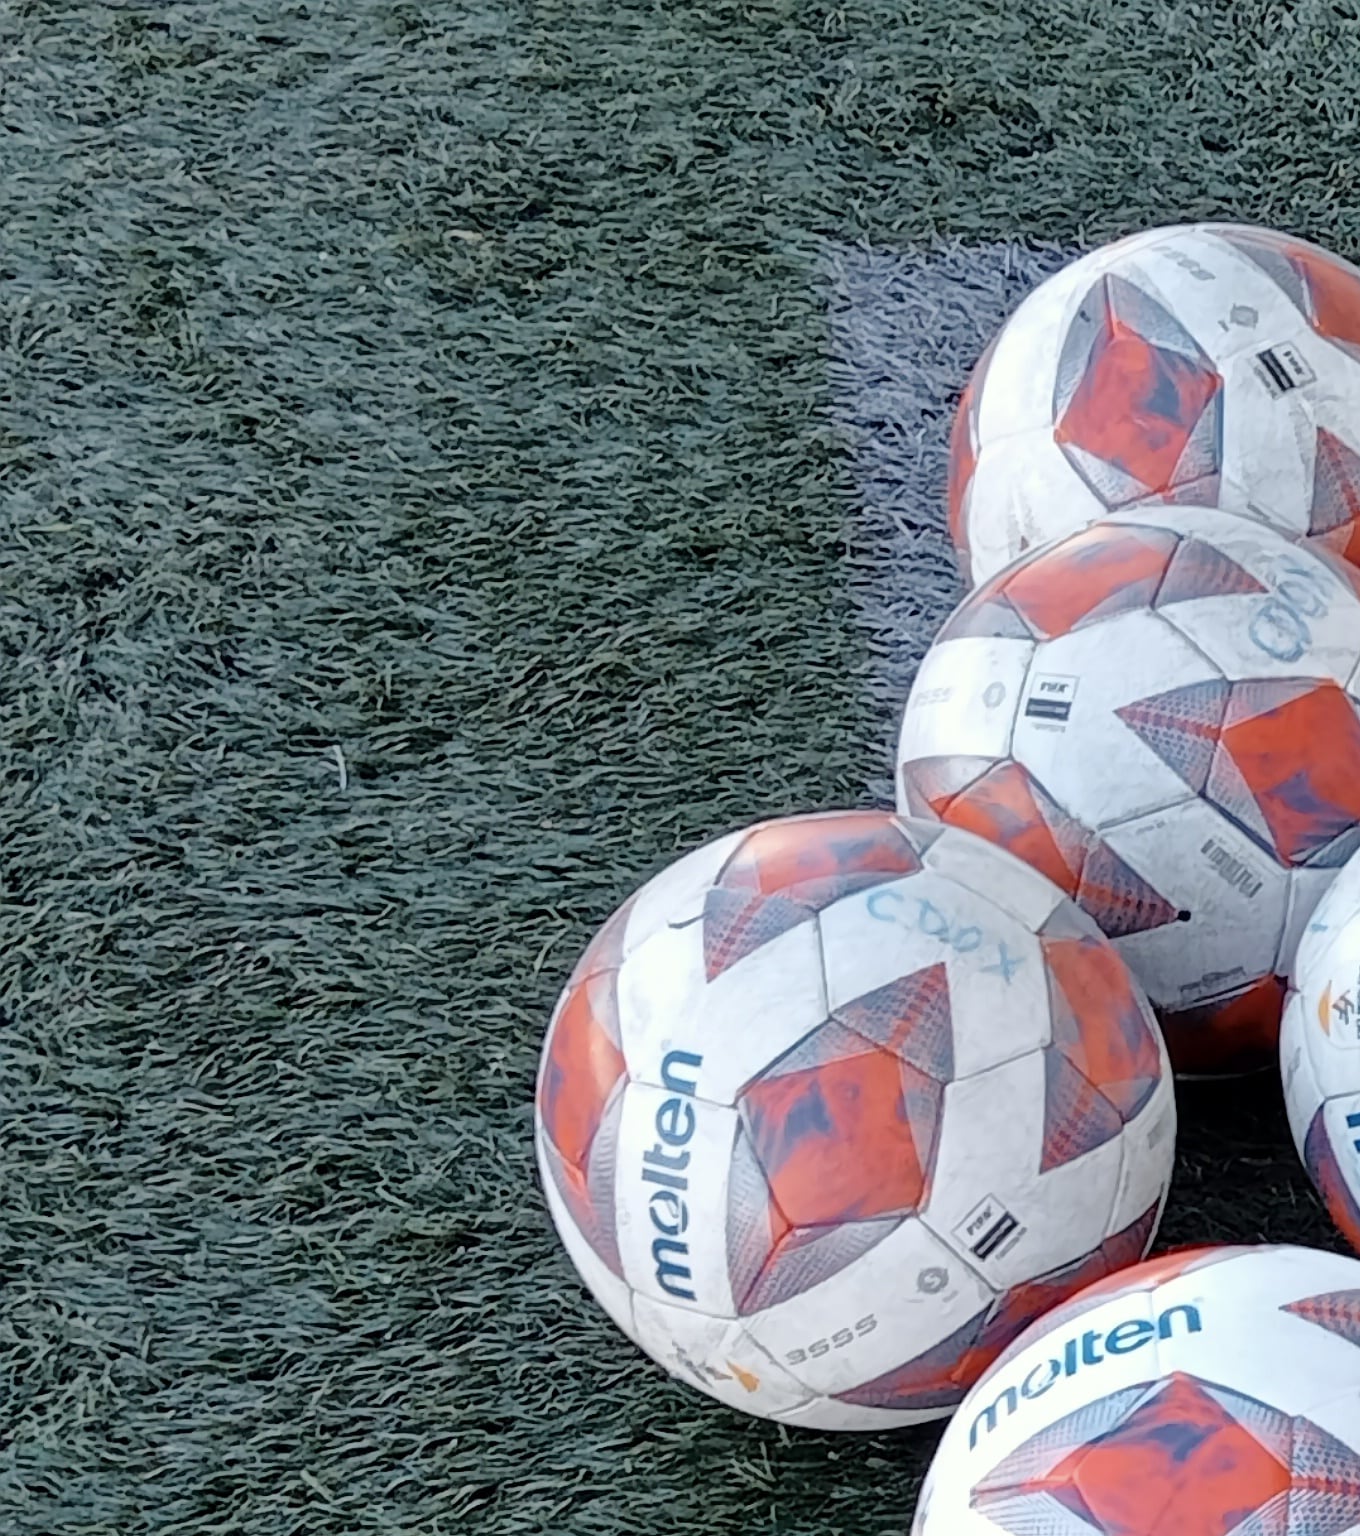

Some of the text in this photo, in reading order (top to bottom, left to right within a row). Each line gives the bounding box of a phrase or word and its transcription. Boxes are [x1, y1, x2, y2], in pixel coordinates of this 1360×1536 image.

[865, 887, 1028, 987] CDOX
[641, 1050, 705, 1303] molten
[970, 1303, 1203, 1453] molten
